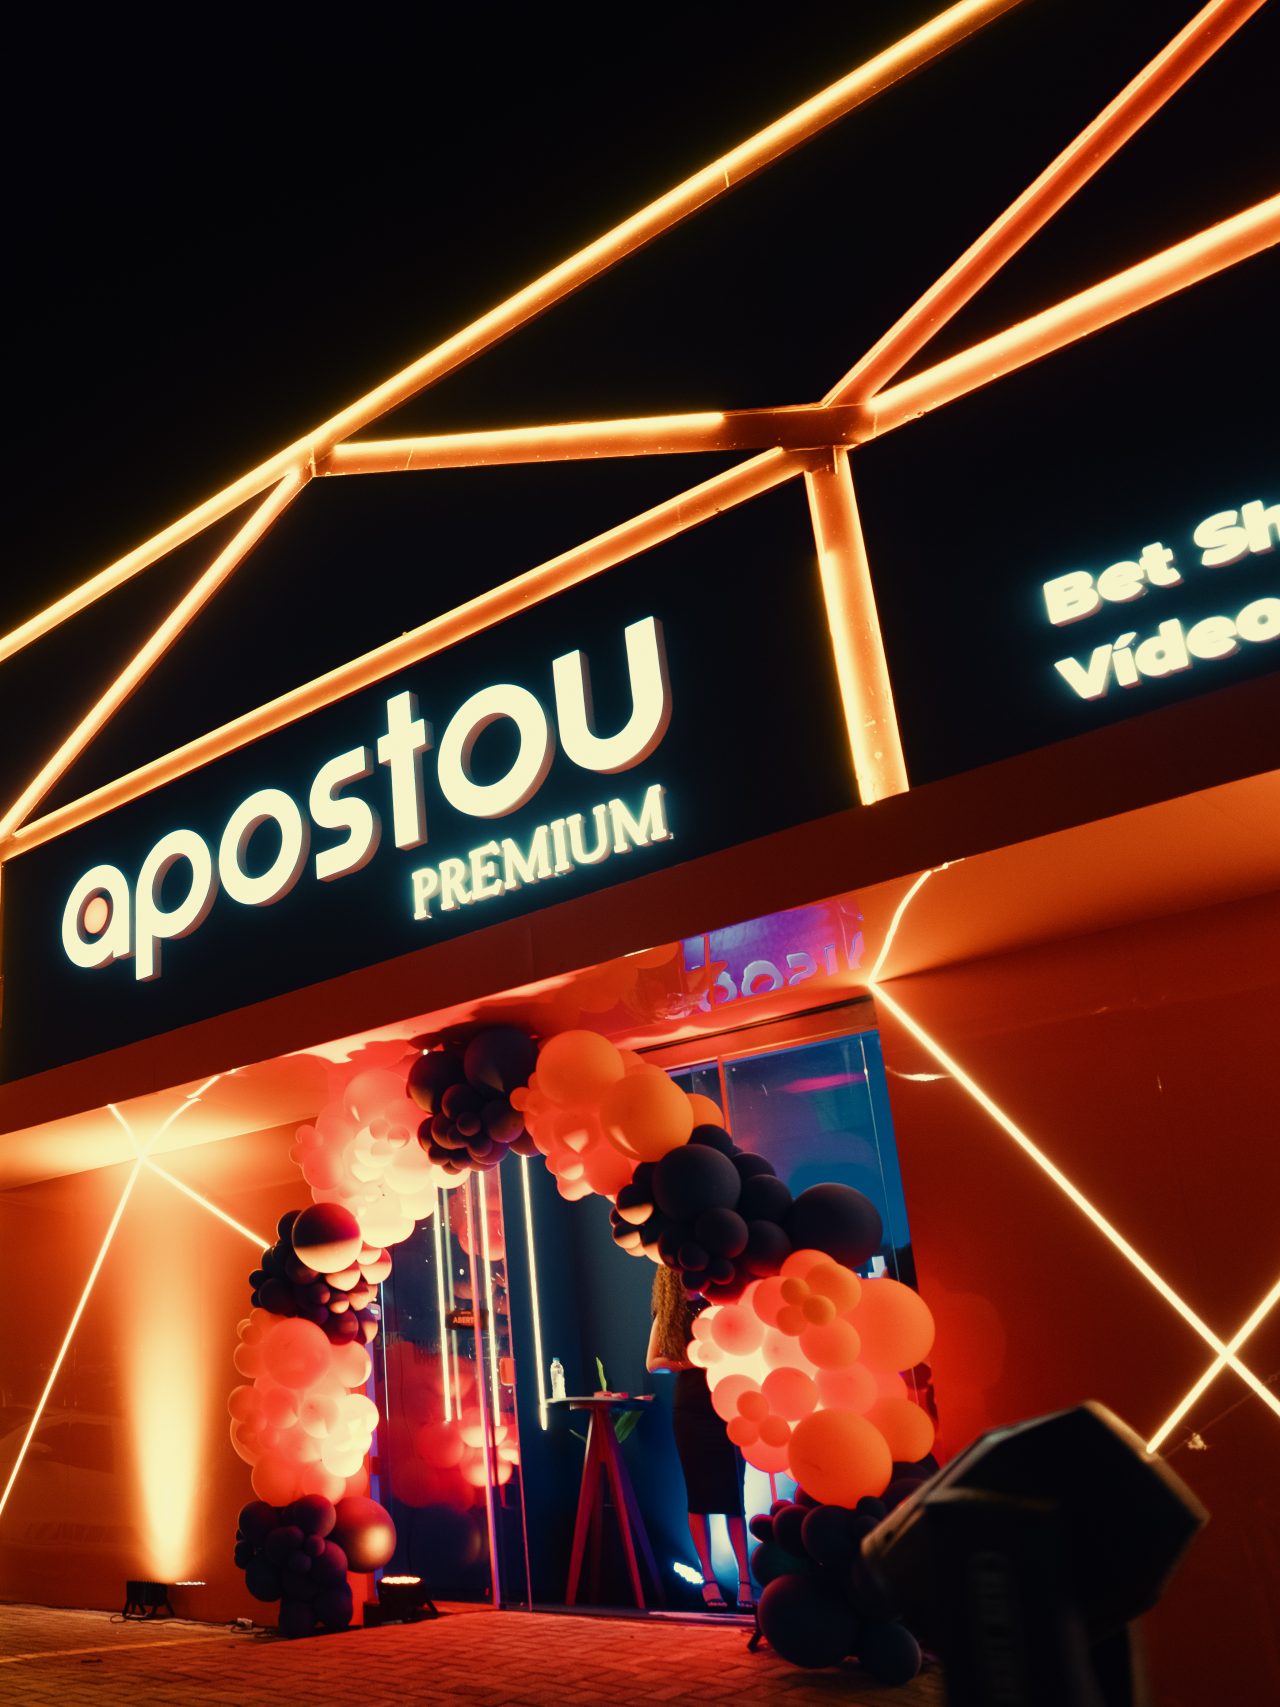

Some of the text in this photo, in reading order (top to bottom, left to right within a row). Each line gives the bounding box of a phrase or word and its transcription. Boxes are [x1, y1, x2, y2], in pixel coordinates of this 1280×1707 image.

[1043, 541, 1184, 627] Bet
[62, 616, 672, 980] apostou
[412, 784, 673, 920] PREMIUM
